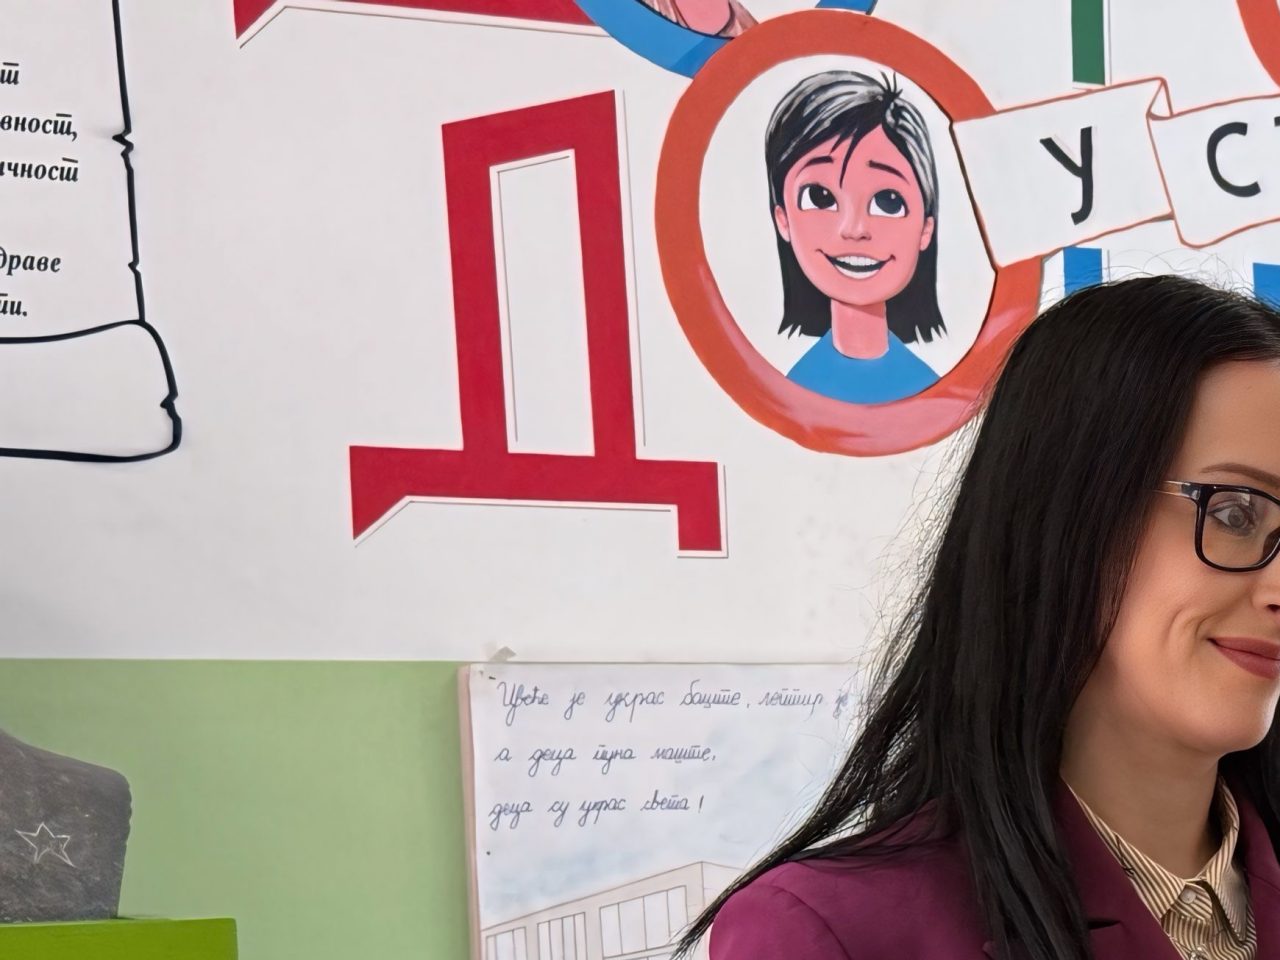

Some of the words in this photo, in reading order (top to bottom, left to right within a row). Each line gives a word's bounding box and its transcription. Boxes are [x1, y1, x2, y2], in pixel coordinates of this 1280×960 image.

[1040, 126, 1094, 225] У
[497, 681, 549, 726] Цвеће
[563, 690, 586, 721] је
[606, 690, 665, 724] украс
[494, 746, 512, 762] а
[528, 746, 577, 778] деца
[593, 743, 637, 775] пуна
[488, 800, 533, 831] деца
[547, 799, 571, 828] су
[579, 796, 627, 824] украс
